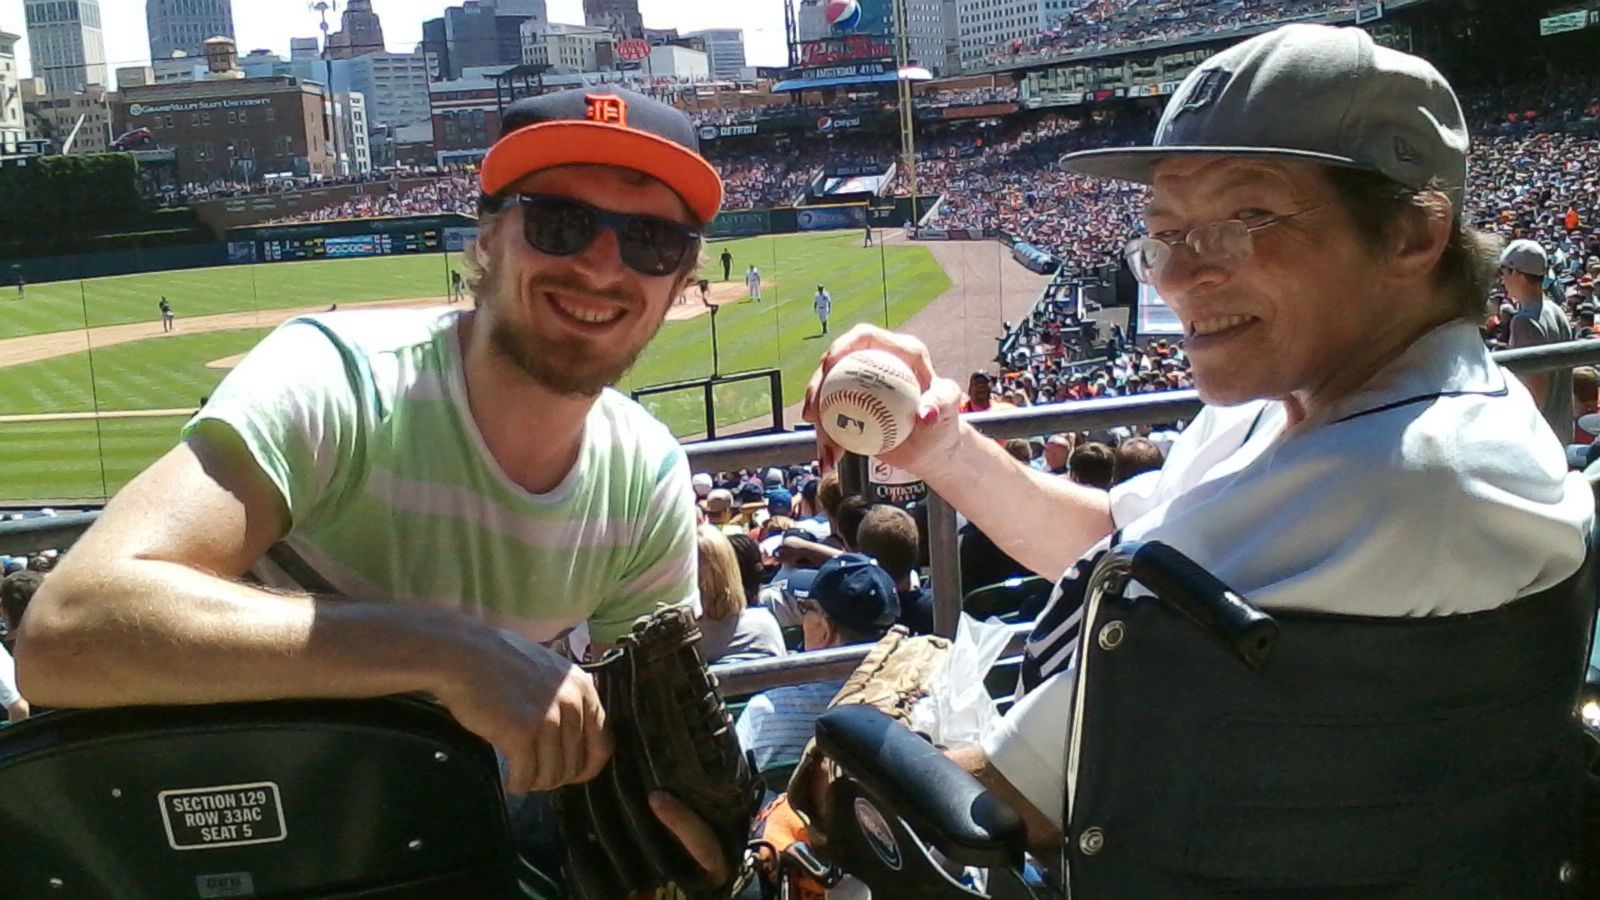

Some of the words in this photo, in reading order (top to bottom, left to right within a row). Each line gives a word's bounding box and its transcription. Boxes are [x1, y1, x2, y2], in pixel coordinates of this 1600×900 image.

[720, 124, 758, 136] DETROIT
[173, 793, 236, 812] SECTION
[240, 791, 266, 806] 129
[184, 811, 219, 827] ROW
[223, 807, 262, 824] 33AC
[201, 825, 237, 842] SEAT
[243, 824, 253, 837] 5
